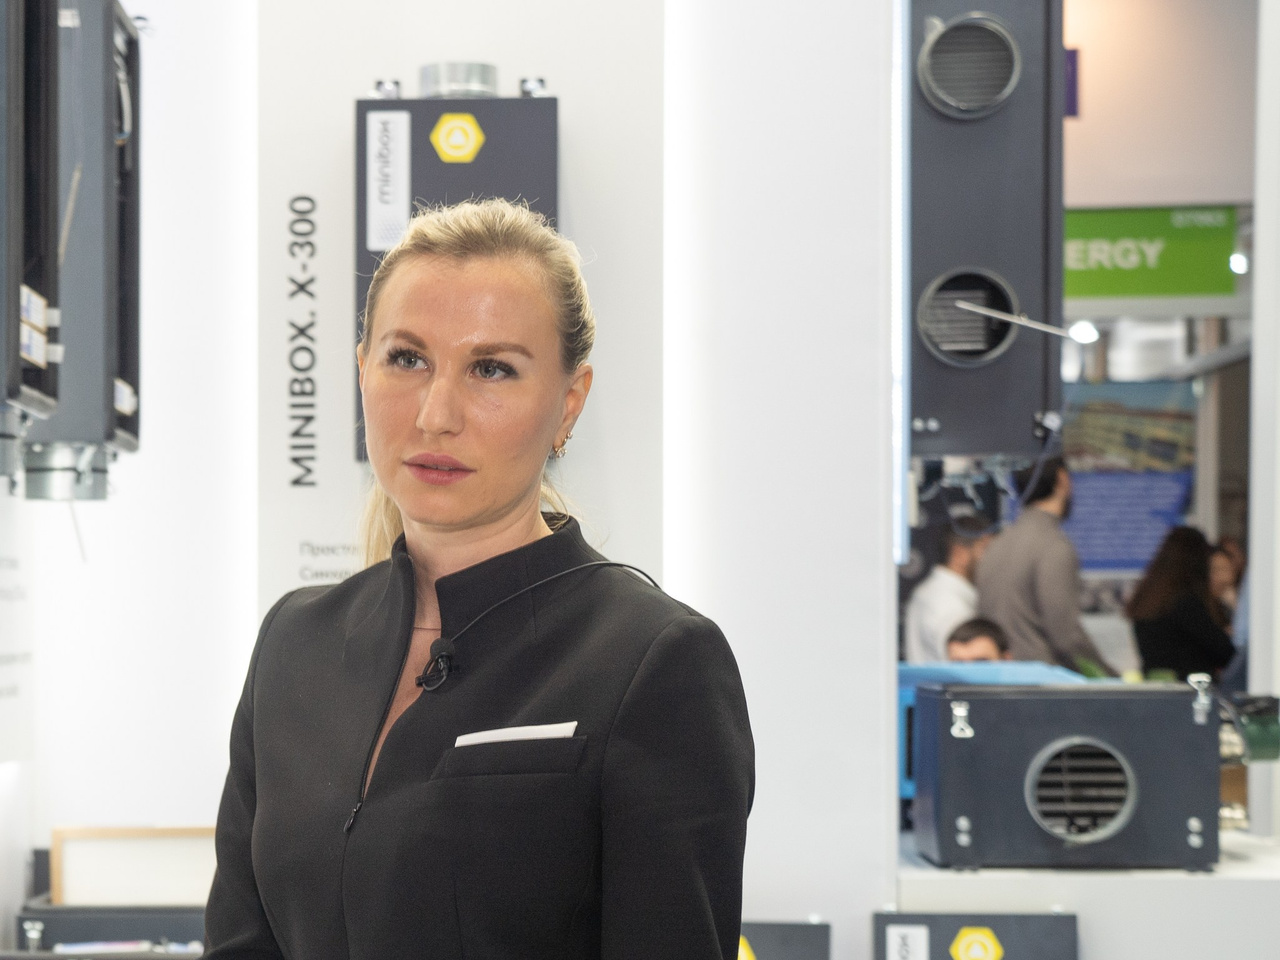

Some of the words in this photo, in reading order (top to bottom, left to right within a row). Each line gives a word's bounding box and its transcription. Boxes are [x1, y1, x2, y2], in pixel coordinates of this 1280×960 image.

[289, 195, 317, 301] X-300
[1065, 237, 1166, 269] ERGY
[290, 311, 317, 487] MINIBOX.
